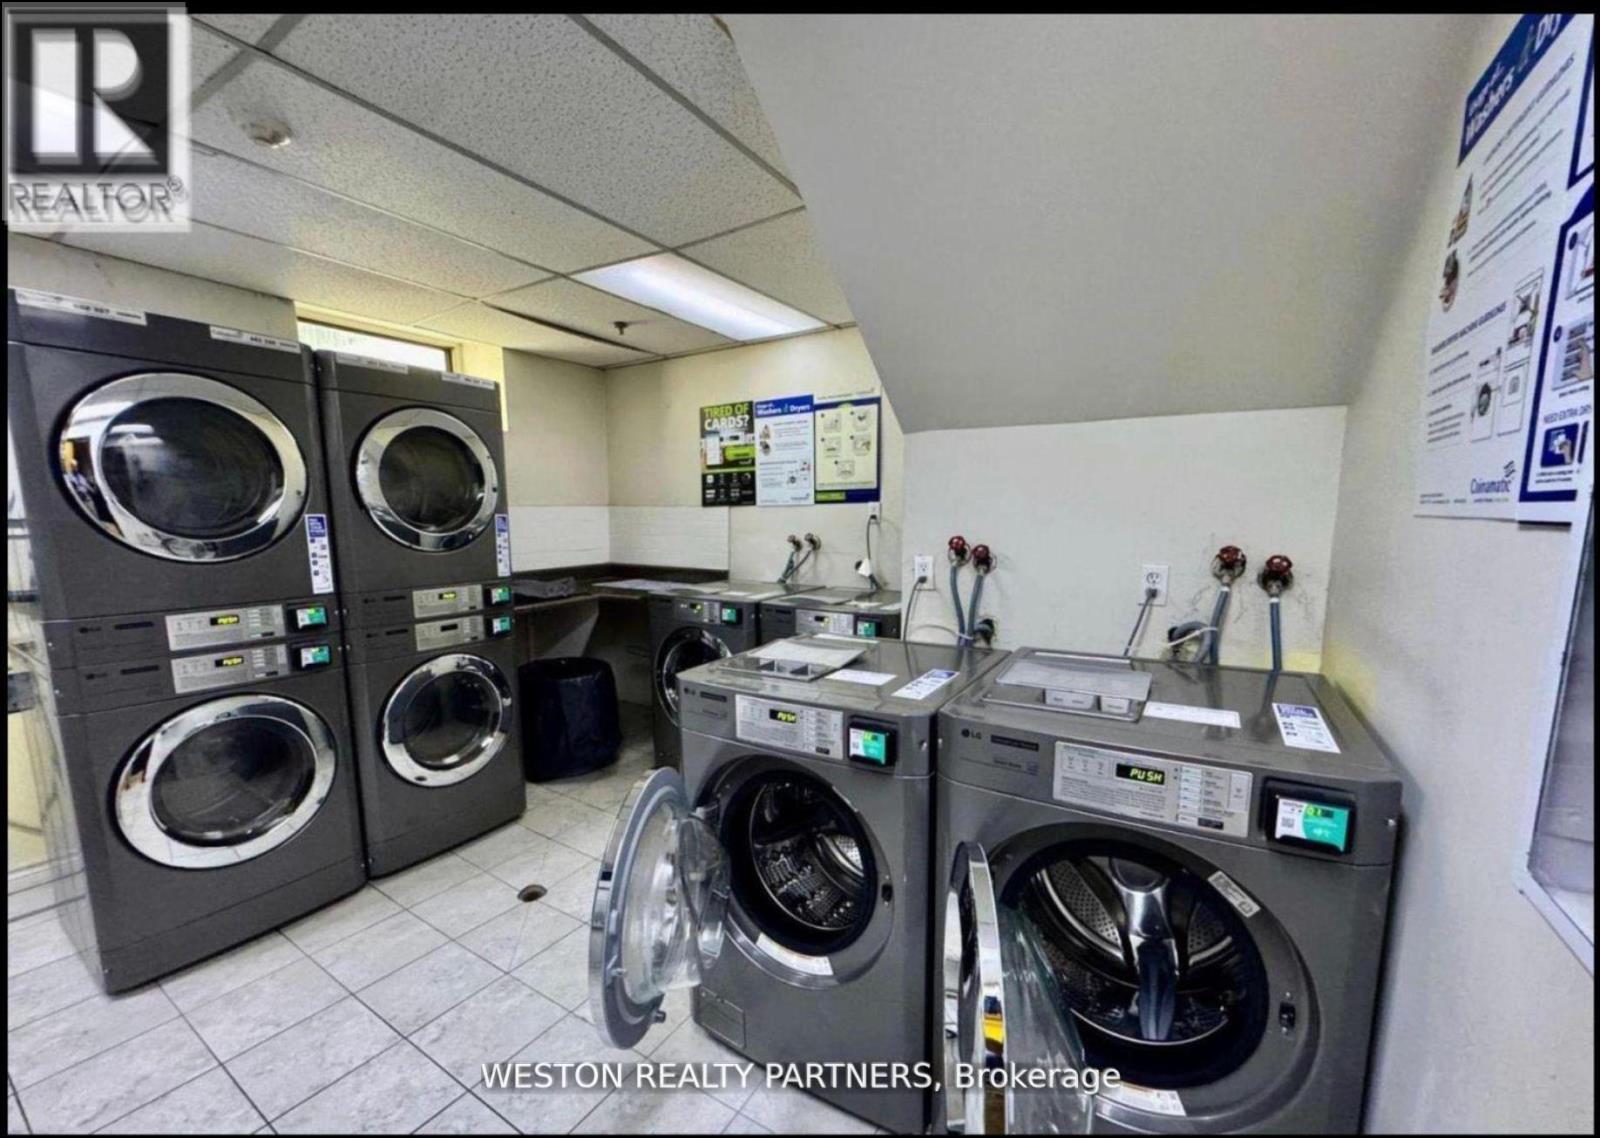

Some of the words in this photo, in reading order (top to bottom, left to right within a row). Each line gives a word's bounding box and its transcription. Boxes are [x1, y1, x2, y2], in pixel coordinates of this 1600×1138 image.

[704, 406, 732, 418] TIRED
[735, 402, 749, 414] OF
[704, 415, 749, 430] CARDS?
